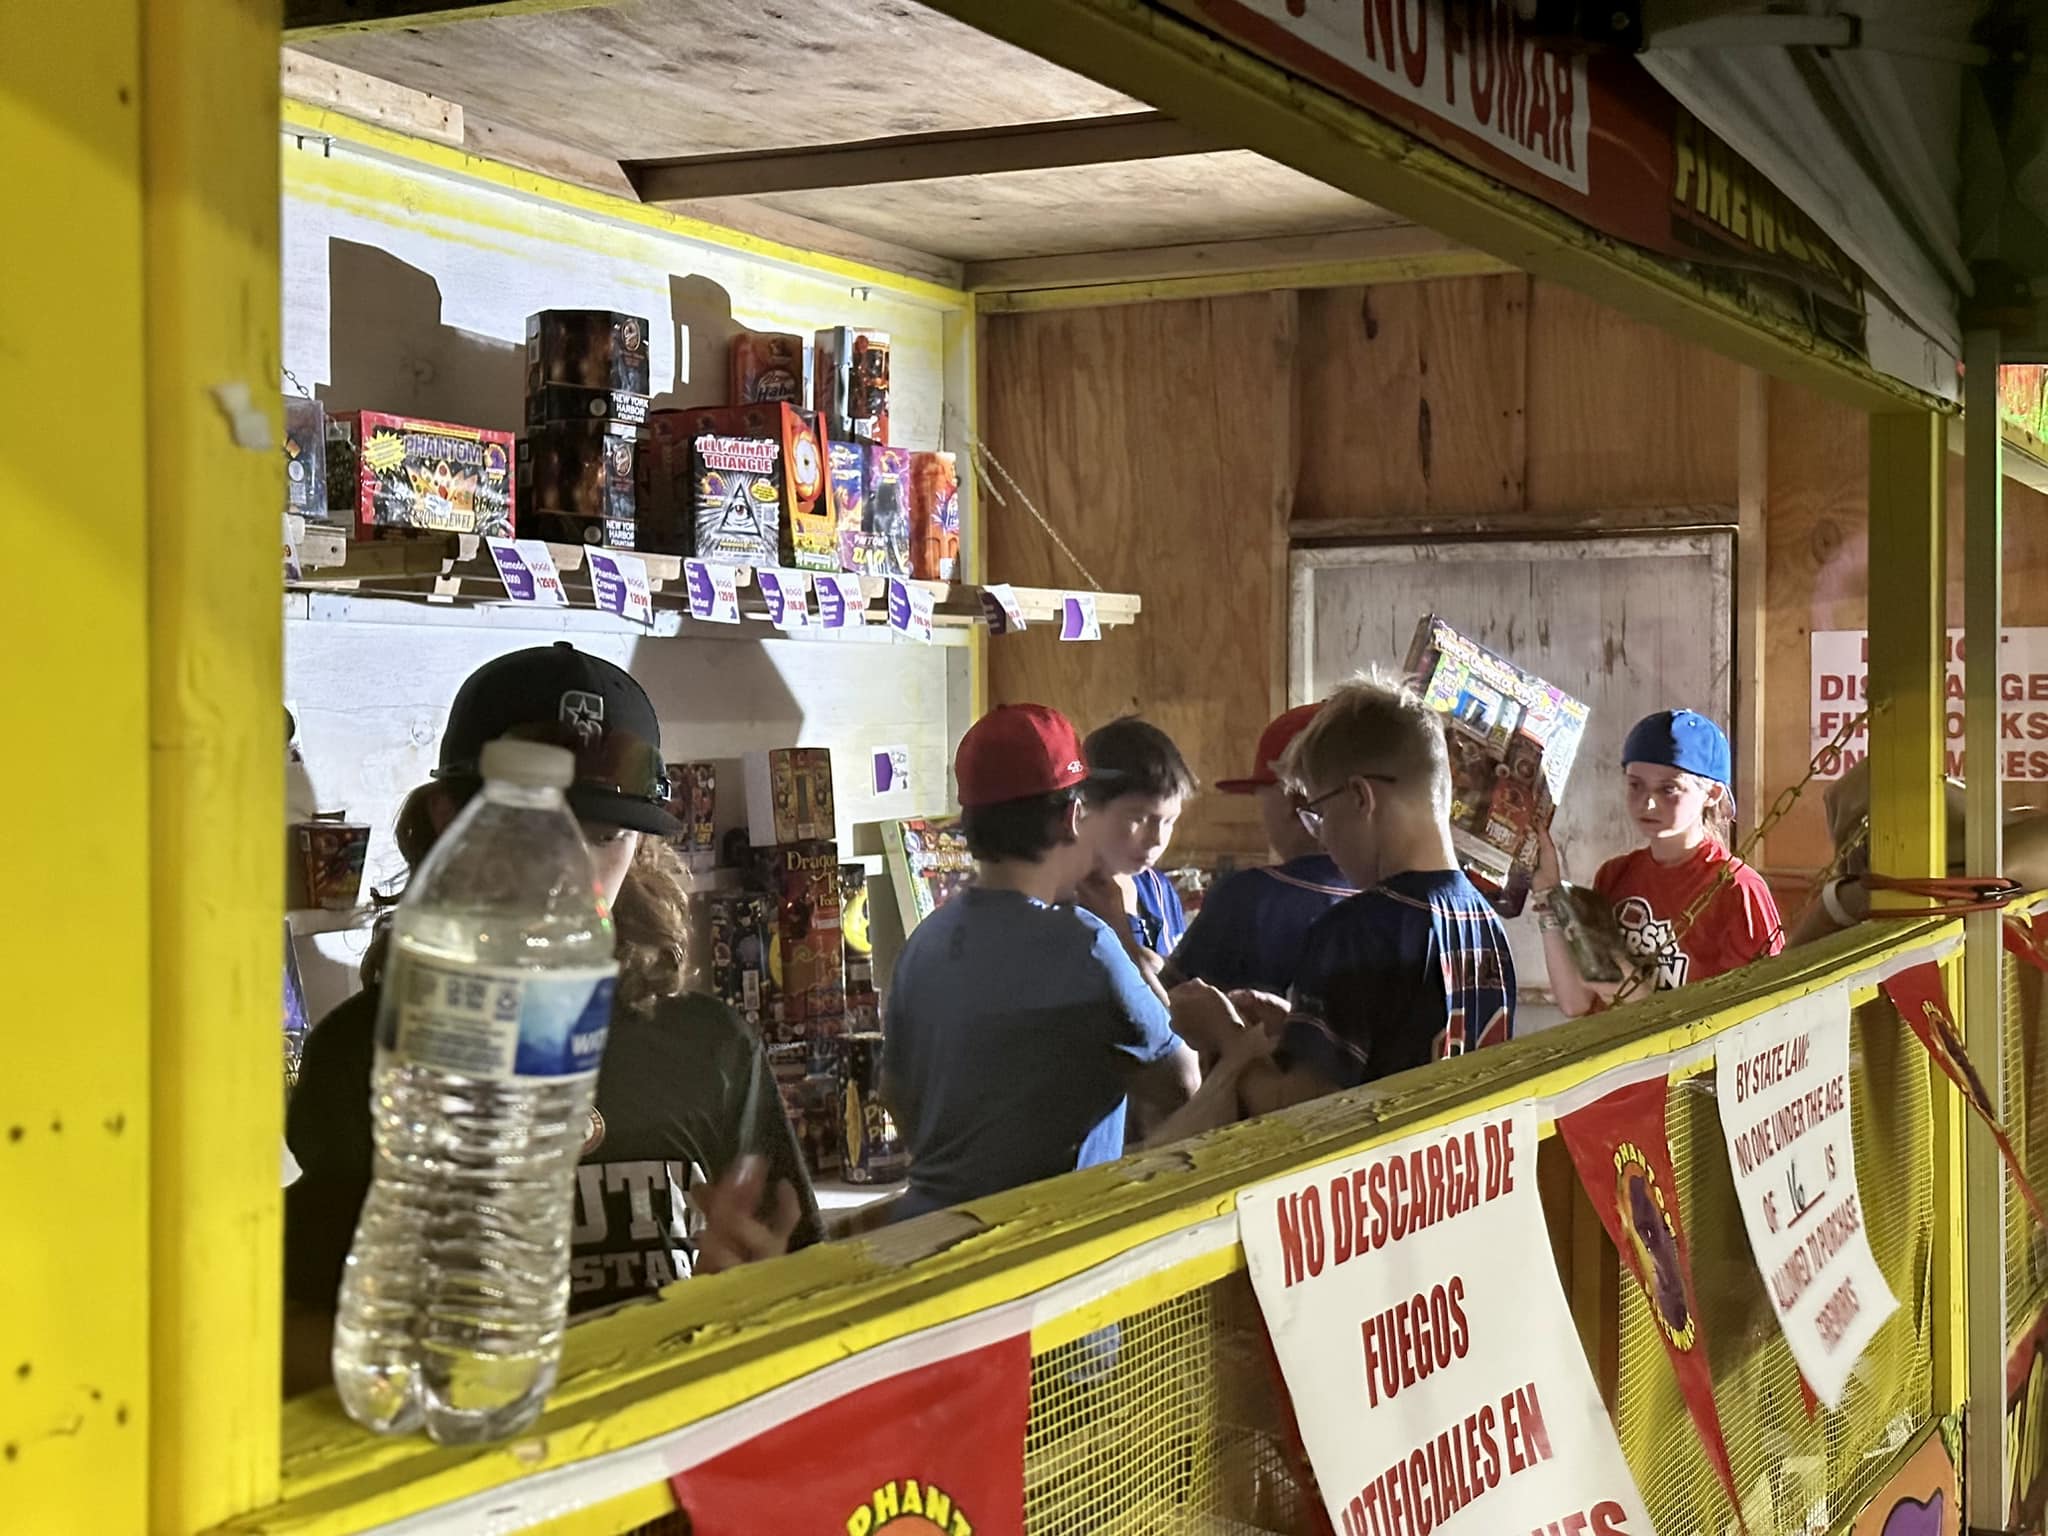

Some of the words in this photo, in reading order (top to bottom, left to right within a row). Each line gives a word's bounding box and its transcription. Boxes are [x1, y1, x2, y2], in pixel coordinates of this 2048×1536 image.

[1444, 0, 1576, 172] FUMAR
[611, 392, 632, 405] NEW
[631, 396, 649, 409] YORK
[616, 403, 646, 417] HARBOR
[403, 434, 484, 465] PHANTOM
[703, 454, 773, 474] TRIANGLE
[446, 509, 473, 530] JEWEL
[1819, 673, 2048, 702] DIAGE
[1736, 1062, 1750, 1103] BY
[1752, 1042, 1784, 1095] STATE
[1734, 1132, 1753, 1178] NO
[1751, 1118, 1775, 1167] ONE
[1771, 1097, 1806, 1151] UNDER
[1804, 1085, 1825, 1131] THE
[1824, 1074, 1845, 1117] AGE
[1276, 1184, 1325, 1288] NO
[1330, 1131, 1479, 1266] DESCARGA
[1484, 1118, 1515, 1203] DE
[1762, 1190, 1779, 1234] OF
[1823, 1143, 1836, 1182] IS
[1360, 1275, 1470, 1409] FUEGOS
[1500, 1382, 1553, 1476] EN
[845, 1478, 973, 1536] PHANT
